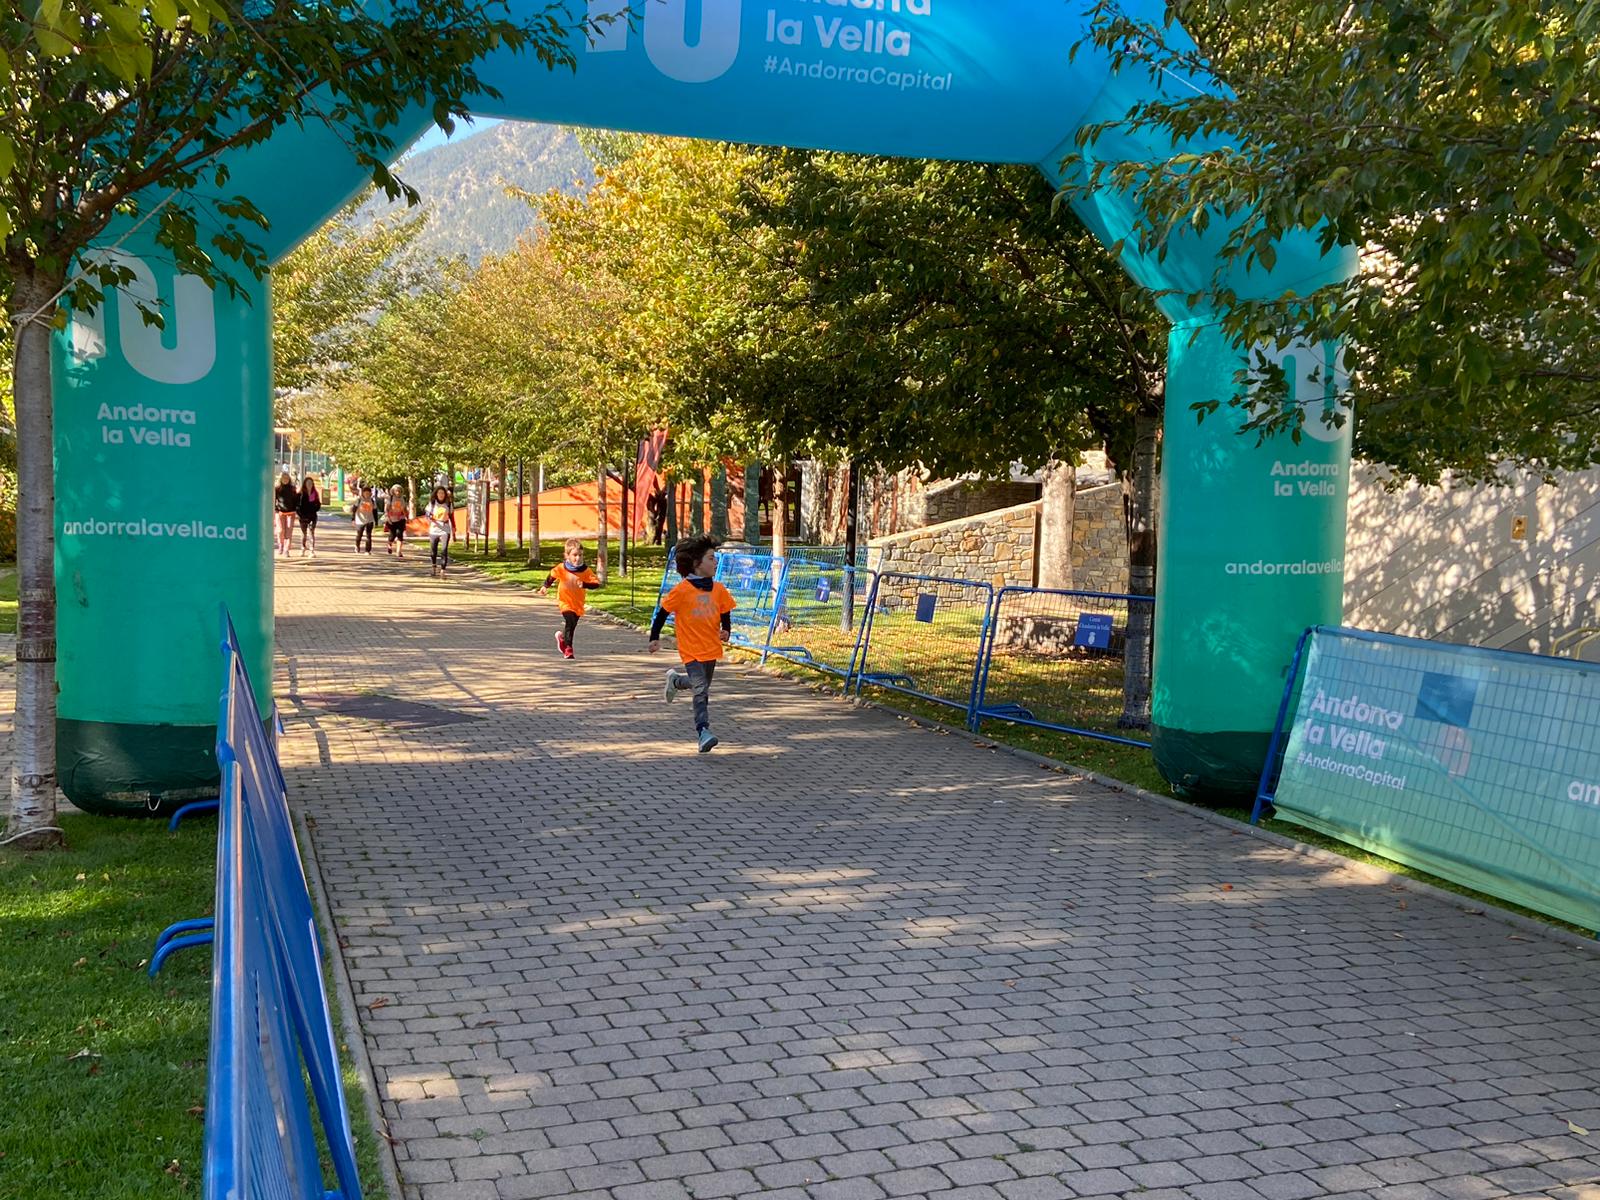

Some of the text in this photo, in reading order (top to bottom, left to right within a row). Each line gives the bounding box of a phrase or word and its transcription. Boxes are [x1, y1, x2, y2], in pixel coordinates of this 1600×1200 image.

[765, 9, 911, 57] la Vella
[764, 55, 953, 91] #AndorraCapital
[97, 402, 196, 425] Andorra
[102, 425, 191, 447] la Vella
[1270, 460, 1339, 476] Andorra
[1274, 480, 1336, 497] la Vella
[63, 517, 247, 540] andorralavella.ad
[1310, 687, 1404, 730] Andorra
[1303, 718, 1386, 760] la Vella
[1296, 750, 1406, 791] #AndorraCapital
